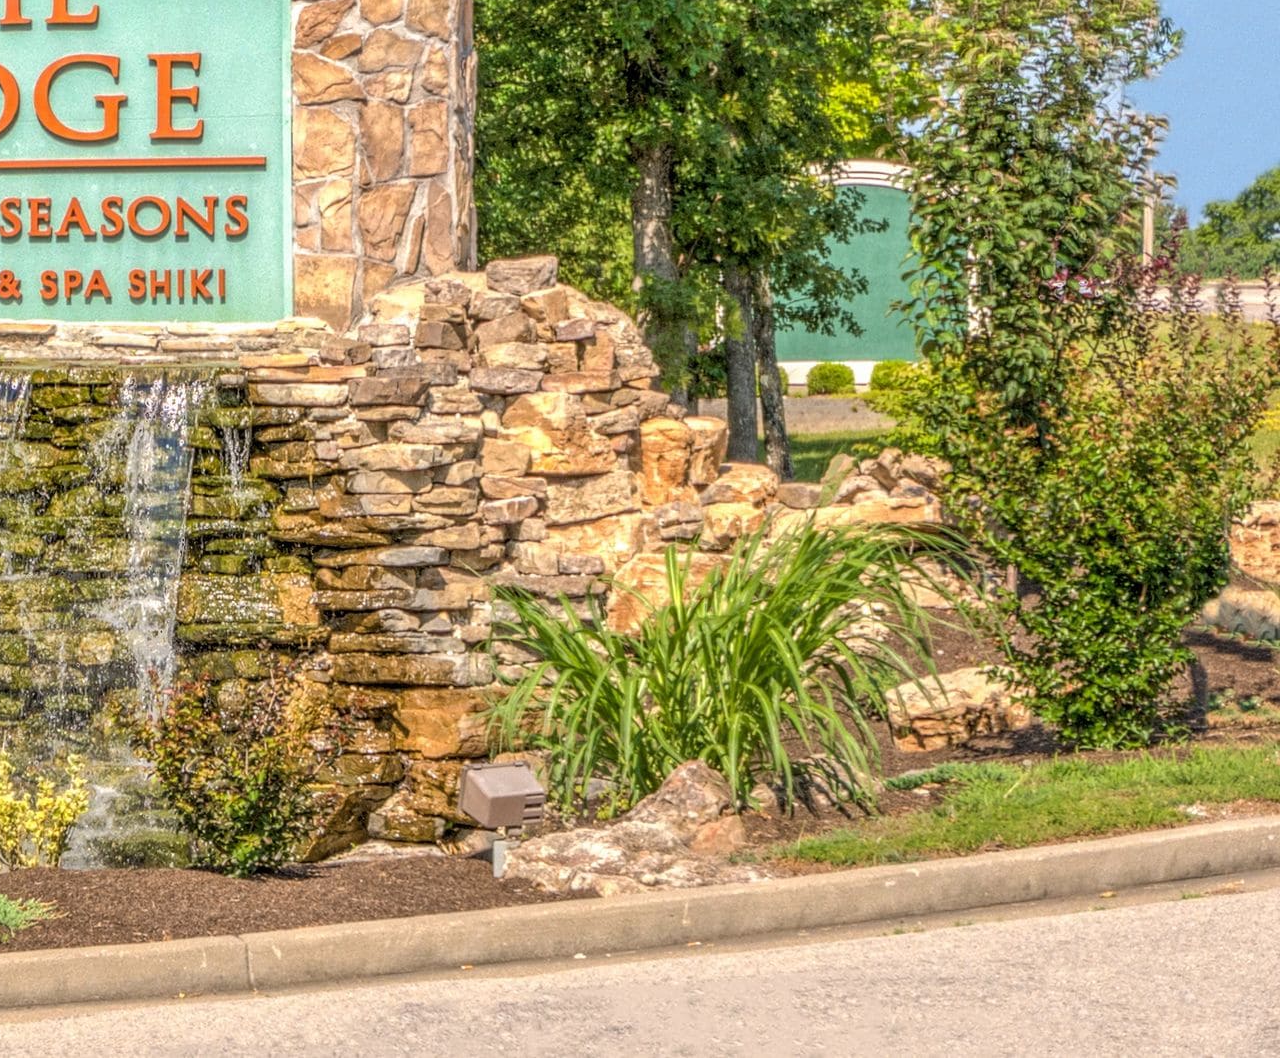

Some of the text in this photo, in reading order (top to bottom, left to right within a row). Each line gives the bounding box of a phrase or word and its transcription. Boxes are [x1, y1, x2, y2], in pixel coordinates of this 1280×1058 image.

[0, 195, 250, 239] SEASONS
[40, 270, 112, 302] SPA
[129, 269, 227, 300] SHIKI
